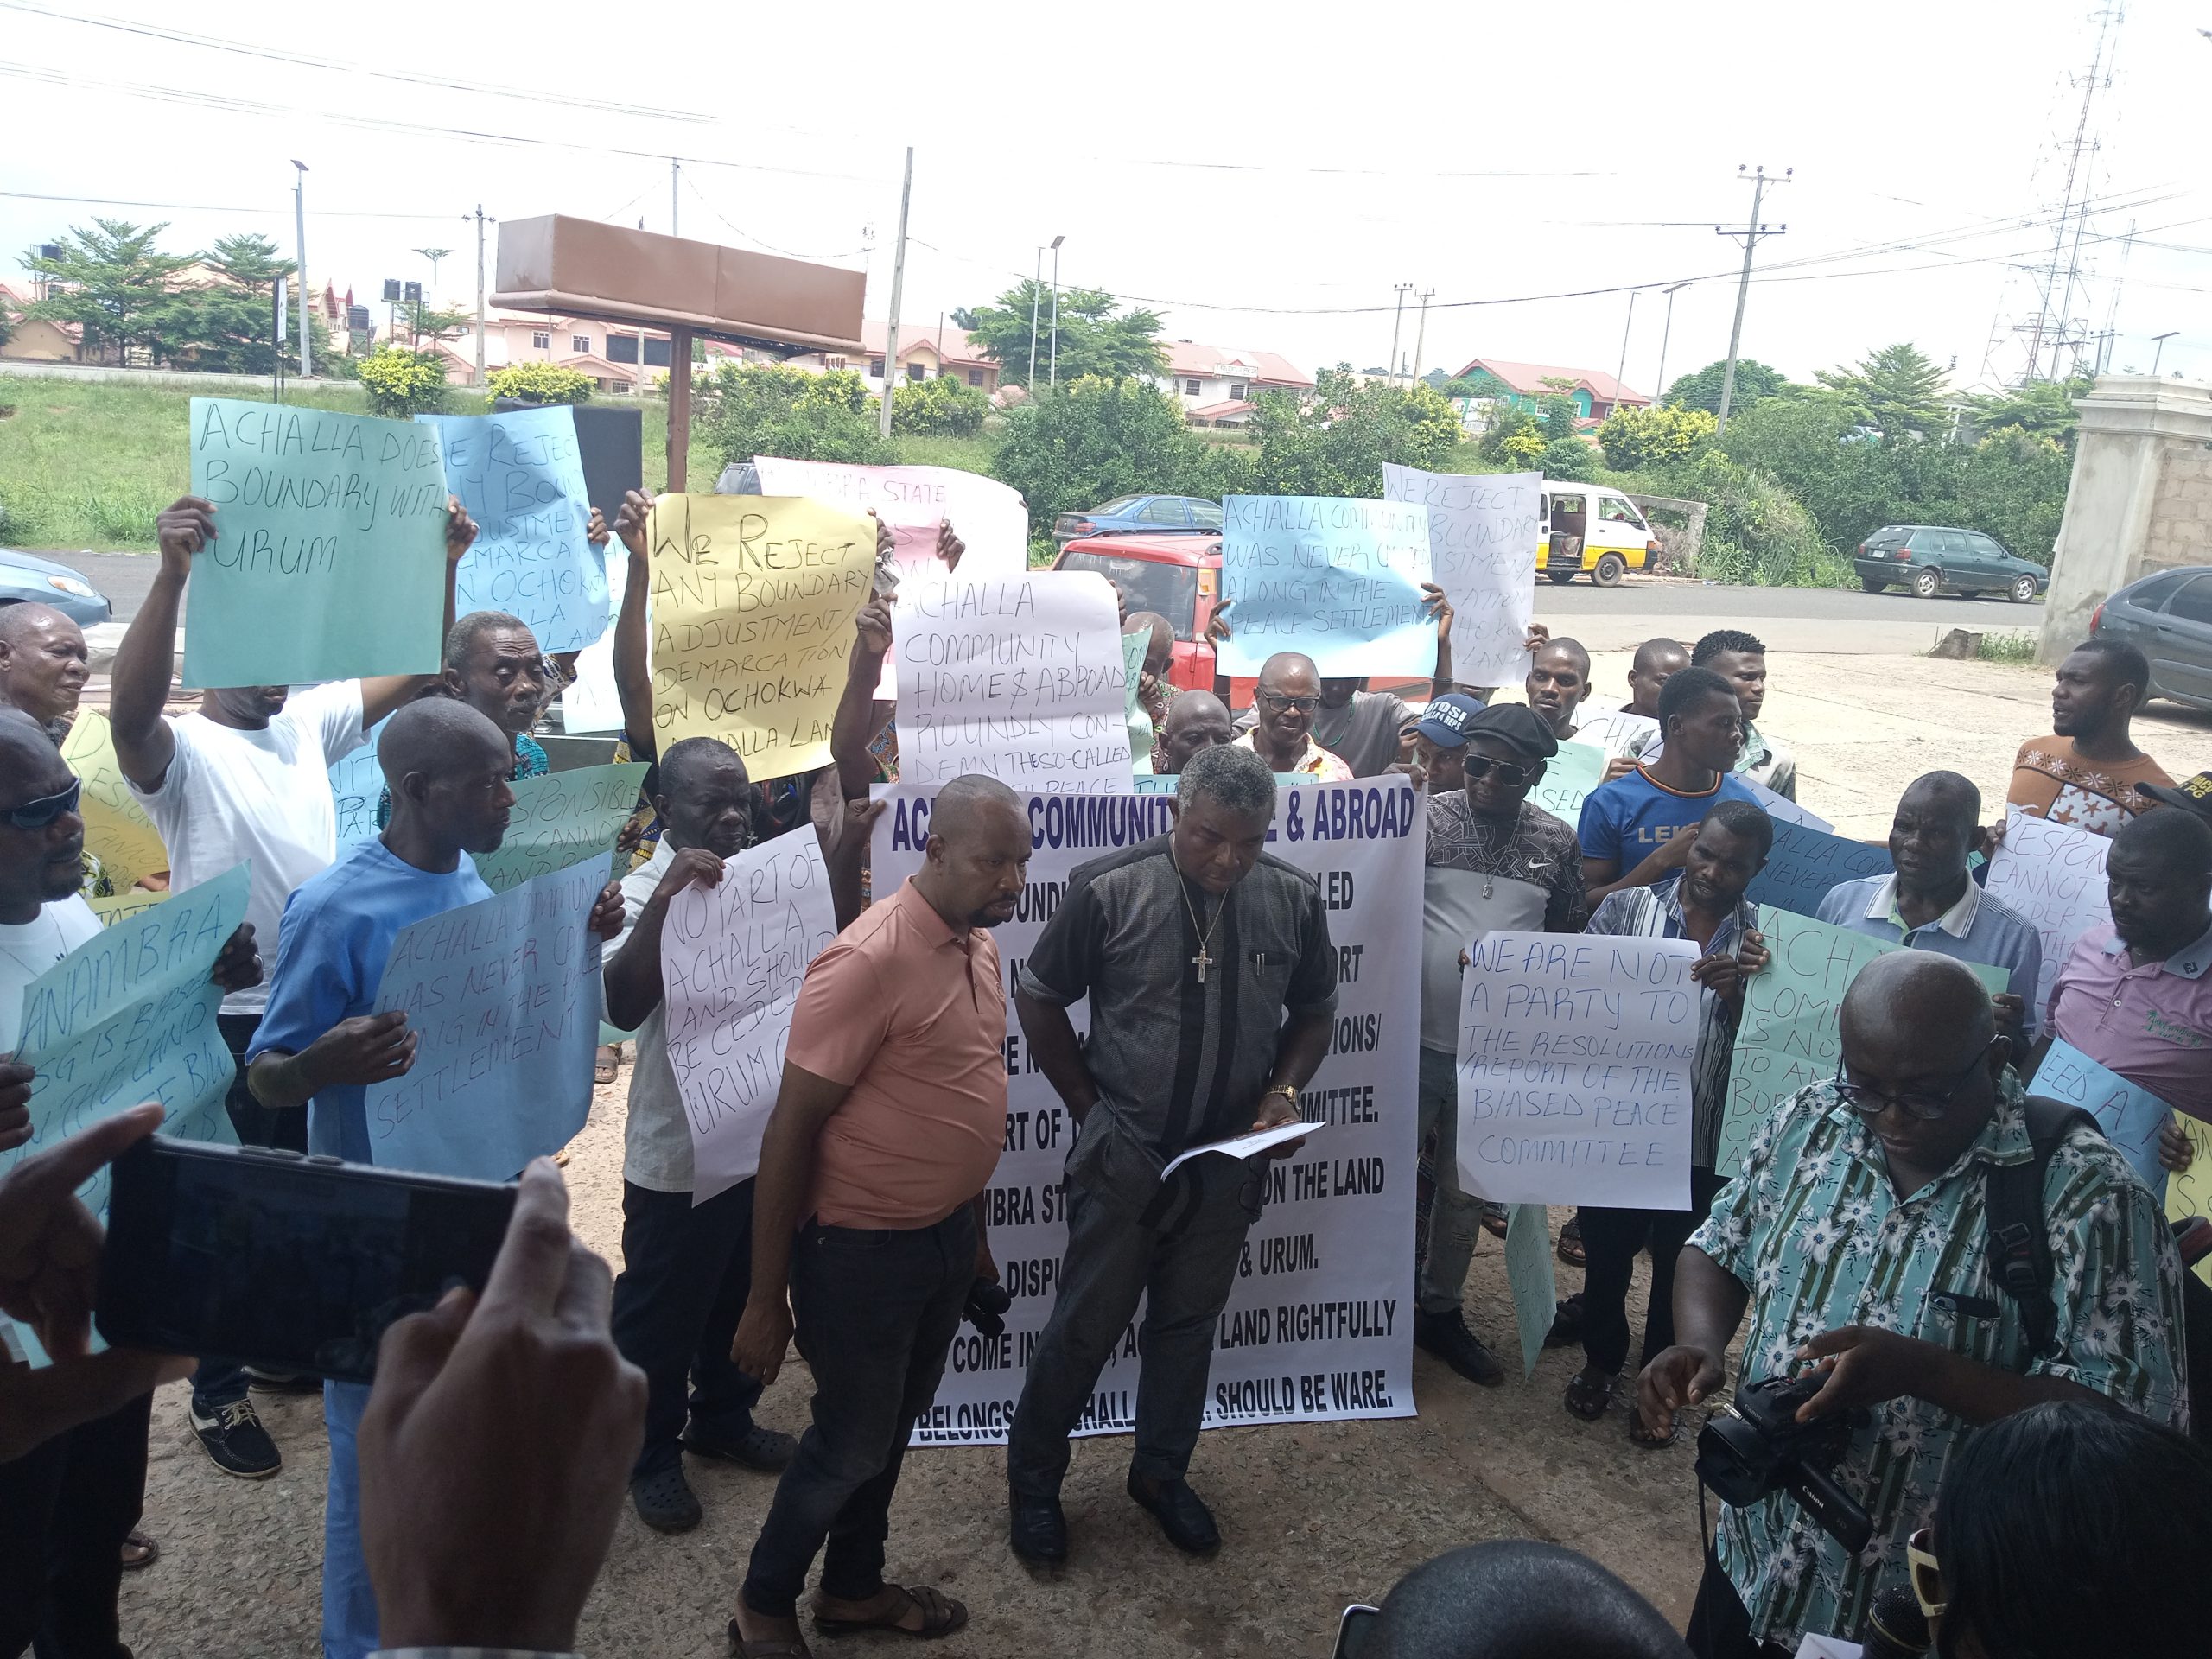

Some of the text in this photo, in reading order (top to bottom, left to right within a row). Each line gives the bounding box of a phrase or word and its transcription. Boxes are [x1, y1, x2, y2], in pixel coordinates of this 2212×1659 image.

[200, 404, 439, 472] ACHALLA DOES
[487, 423, 576, 472] REJEC
[206, 460, 446, 531] BOUNDARY WITH
[883, 480, 945, 504] STATE
[1224, 499, 1324, 532] ACHALLA
[213, 529, 338, 575] URUM
[739, 513, 855, 572] REJECT
[1227, 543, 1280, 568] WAS
[1293, 543, 1369, 570] NEVER
[654, 572, 720, 610] ANY
[735, 569, 870, 614] BOUNDARY
[1227, 578, 1392, 603] ALONG IN THE
[1231, 611, 1302, 643] PEACE
[906, 632, 1080, 678] COMMUNITY
[655, 672, 833, 729] ON OCHOKWA
[1036, 665, 1126, 707] ABROAD
[789, 714, 834, 748] LAN
[916, 713, 1054, 753] ROUNDLY
[1443, 715, 1462, 731] REPS
[1028, 787, 1414, 849] COMMUNIT & ABROAD
[790, 842, 818, 890] OF
[1999, 813, 2107, 874] RESPON
[1988, 858, 2096, 904] CANNOT
[388, 903, 508, 977] ACHALLA
[668, 900, 804, 1010] ACHALLA
[1472, 938, 1694, 985] WE ARE NOT
[13, 894, 221, 1063] ANAMBRA
[460, 938, 539, 1003] NEVER
[666, 986, 736, 1044] LAND
[1469, 982, 1688, 1030] A PARTY TO
[1742, 1012, 1770, 1044] IS
[91, 1024, 119, 1064] IS
[132, 1001, 207, 1082] LAND
[668, 1034, 701, 1087] BE
[1465, 1025, 1694, 1060] THE RESOLUTIONS
[1734, 1047, 1770, 1074] TO
[377, 1000, 575, 1139] SETTLEMENT
[684, 1046, 772, 1135] URUM
[1583, 1062, 1622, 1089] OF
[1630, 1065, 1681, 1094] THE
[1036, 1109, 1062, 1150] OF
[1474, 1088, 1678, 1127] BIASED PEACE
[1478, 1135, 1664, 1168] COMMITTEE
[1293, 1161, 1328, 1201] THE
[1334, 1157, 1384, 1196] LAND
[1239, 1241, 1253, 1278] &
[1260, 1233, 1319, 1276] URUM.
[952, 1333, 1011, 1373] COME
[1221, 1308, 1271, 1350] LAND
[1277, 1300, 1396, 1344] RIGHTFULLY
[918, 1399, 1014, 1441] BELONGS
[1216, 1376, 1295, 1420] SHOULD
[1300, 1374, 1328, 1414] BE
[1331, 1370, 1394, 1411] WARE.
[1744, 1403, 1763, 1421] Canon
[1802, 1484, 1825, 1509] Canon
